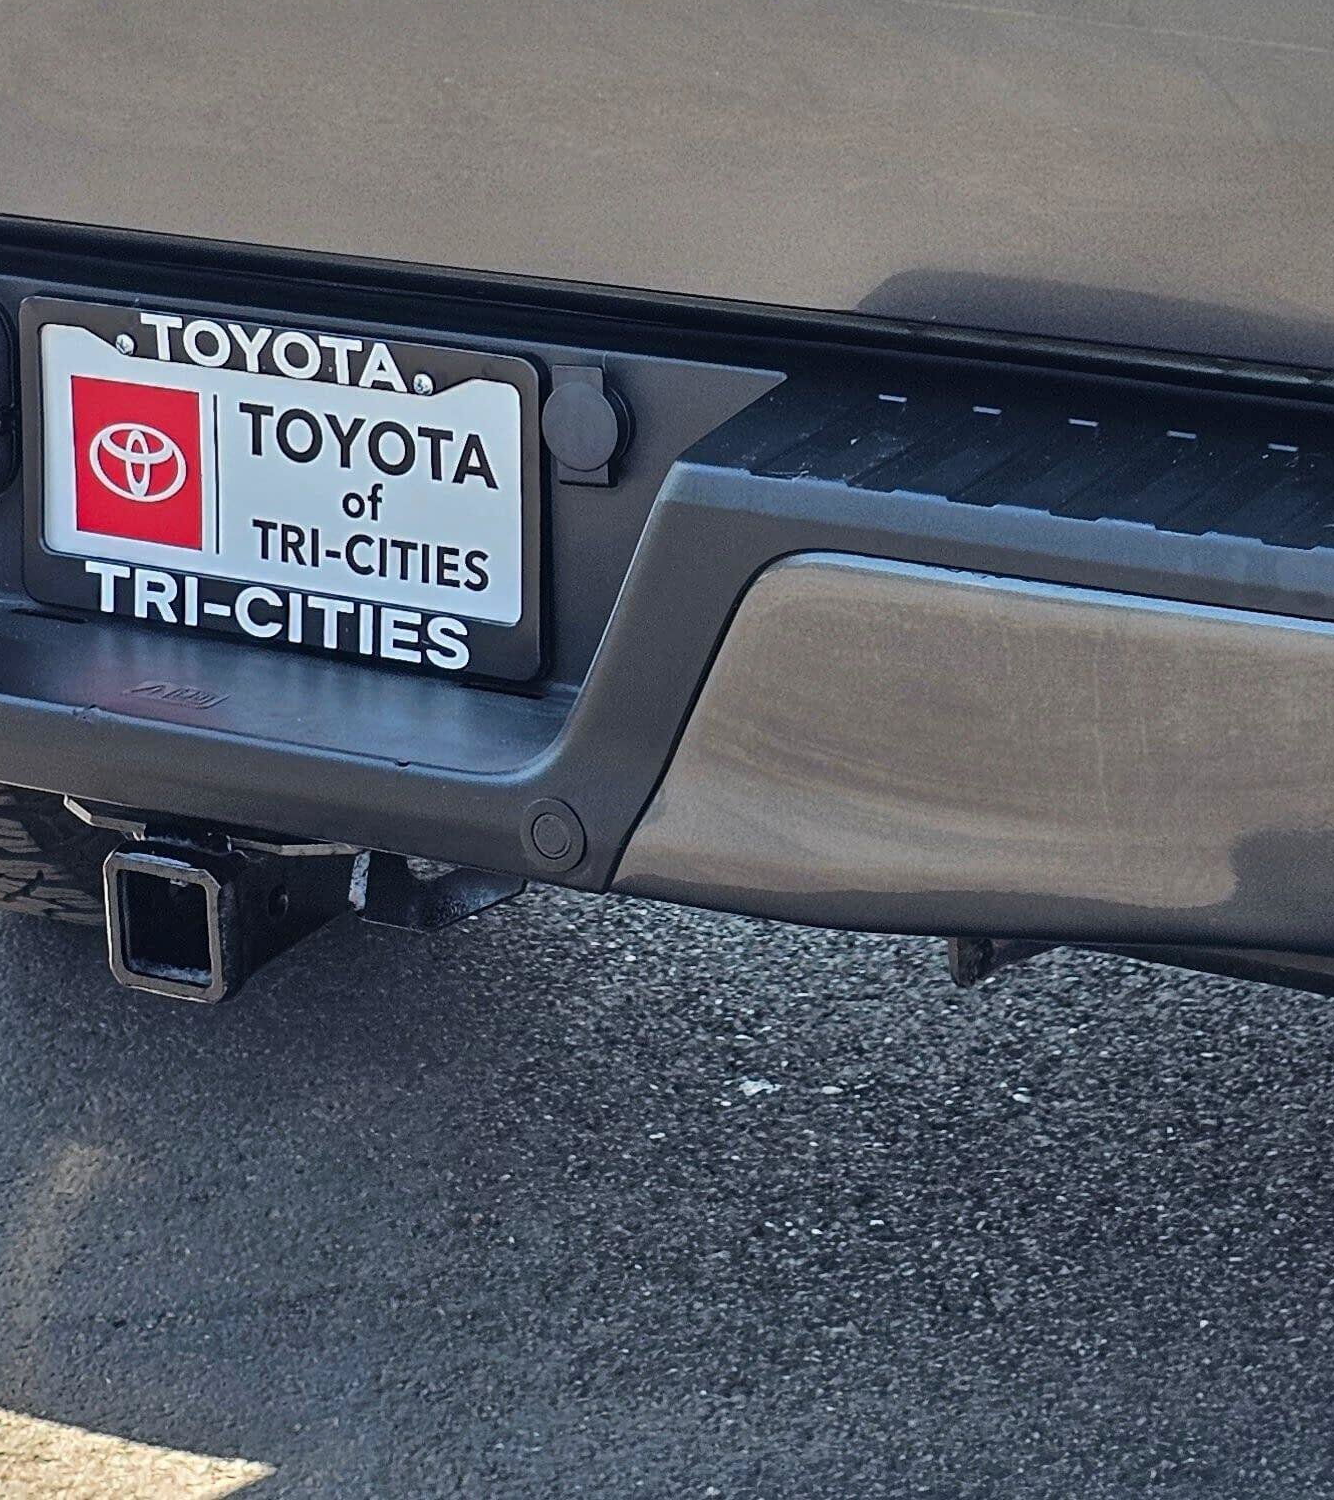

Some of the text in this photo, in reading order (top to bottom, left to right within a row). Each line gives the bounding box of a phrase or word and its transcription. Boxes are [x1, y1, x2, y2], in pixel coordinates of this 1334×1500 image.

[139, 313, 406, 393] TOYOTA
[239, 402, 499, 490] TOYOTA
[341, 483, 384, 521] of
[251, 518, 490, 593] TRI-CITIES
[84, 559, 471, 671] TRI-CITIES
